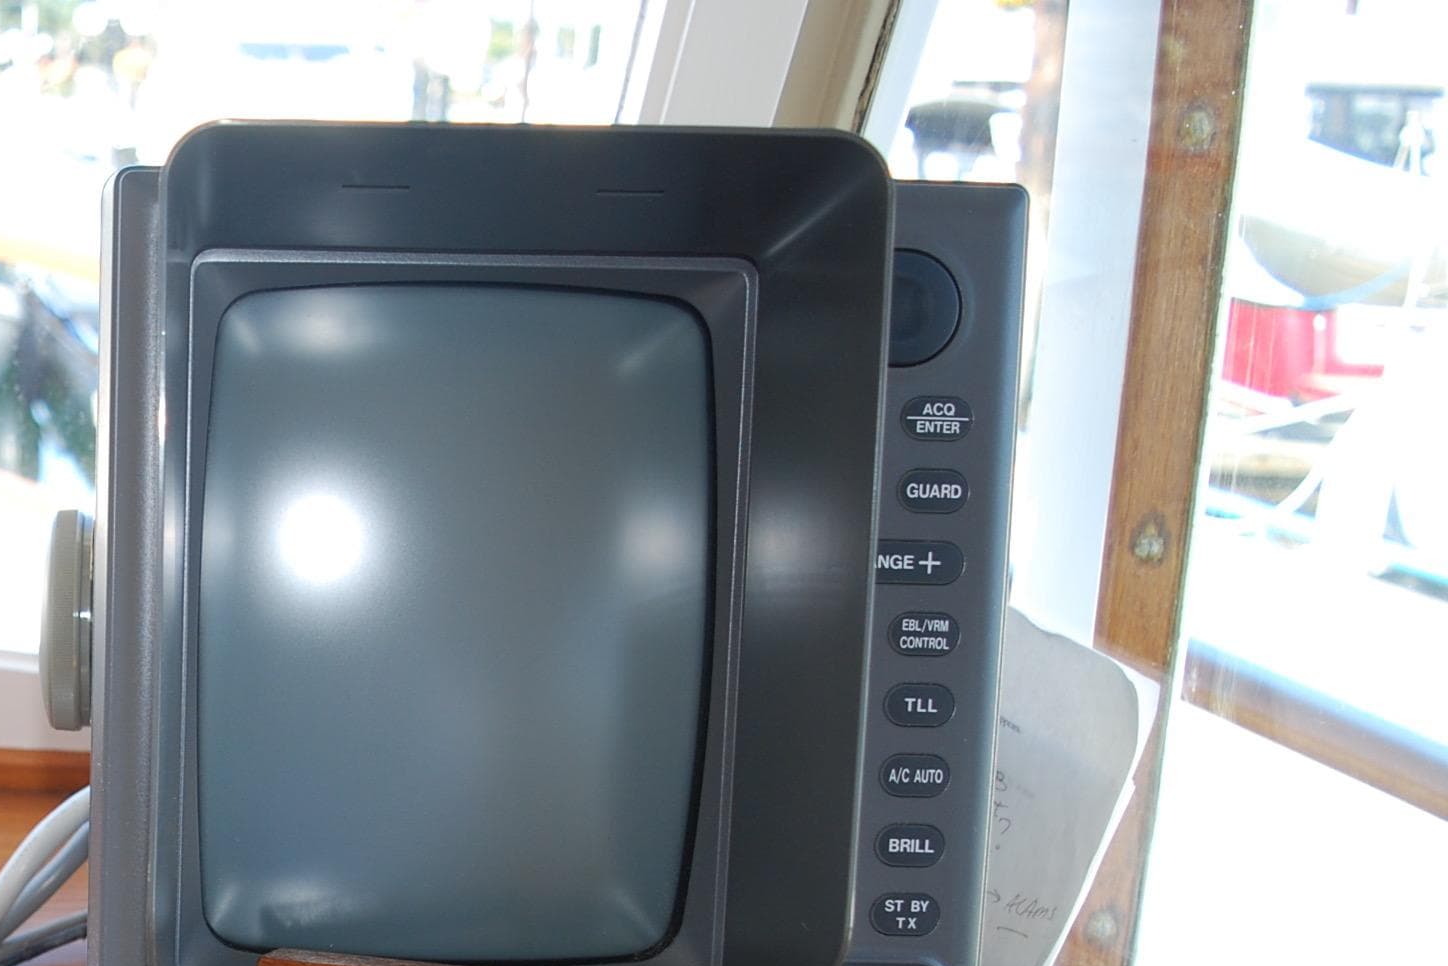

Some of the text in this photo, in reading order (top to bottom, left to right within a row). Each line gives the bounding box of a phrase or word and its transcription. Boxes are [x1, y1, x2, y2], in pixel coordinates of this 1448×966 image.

[922, 403, 955, 416] ACQ
[916, 421, 960, 434] ENTER
[906, 484, 962, 499] GUARD
[874, 555, 914, 570] NGE
[902, 619, 949, 632] EBL/VRM
[900, 636, 949, 649] CONTROL
[905, 698, 938, 713] TLL
[888, 768, 944, 784] A/C AUTO
[888, 838, 934, 853] BRILL
[884, 900, 929, 912] ST BY
[896, 918, 916, 929] TX
